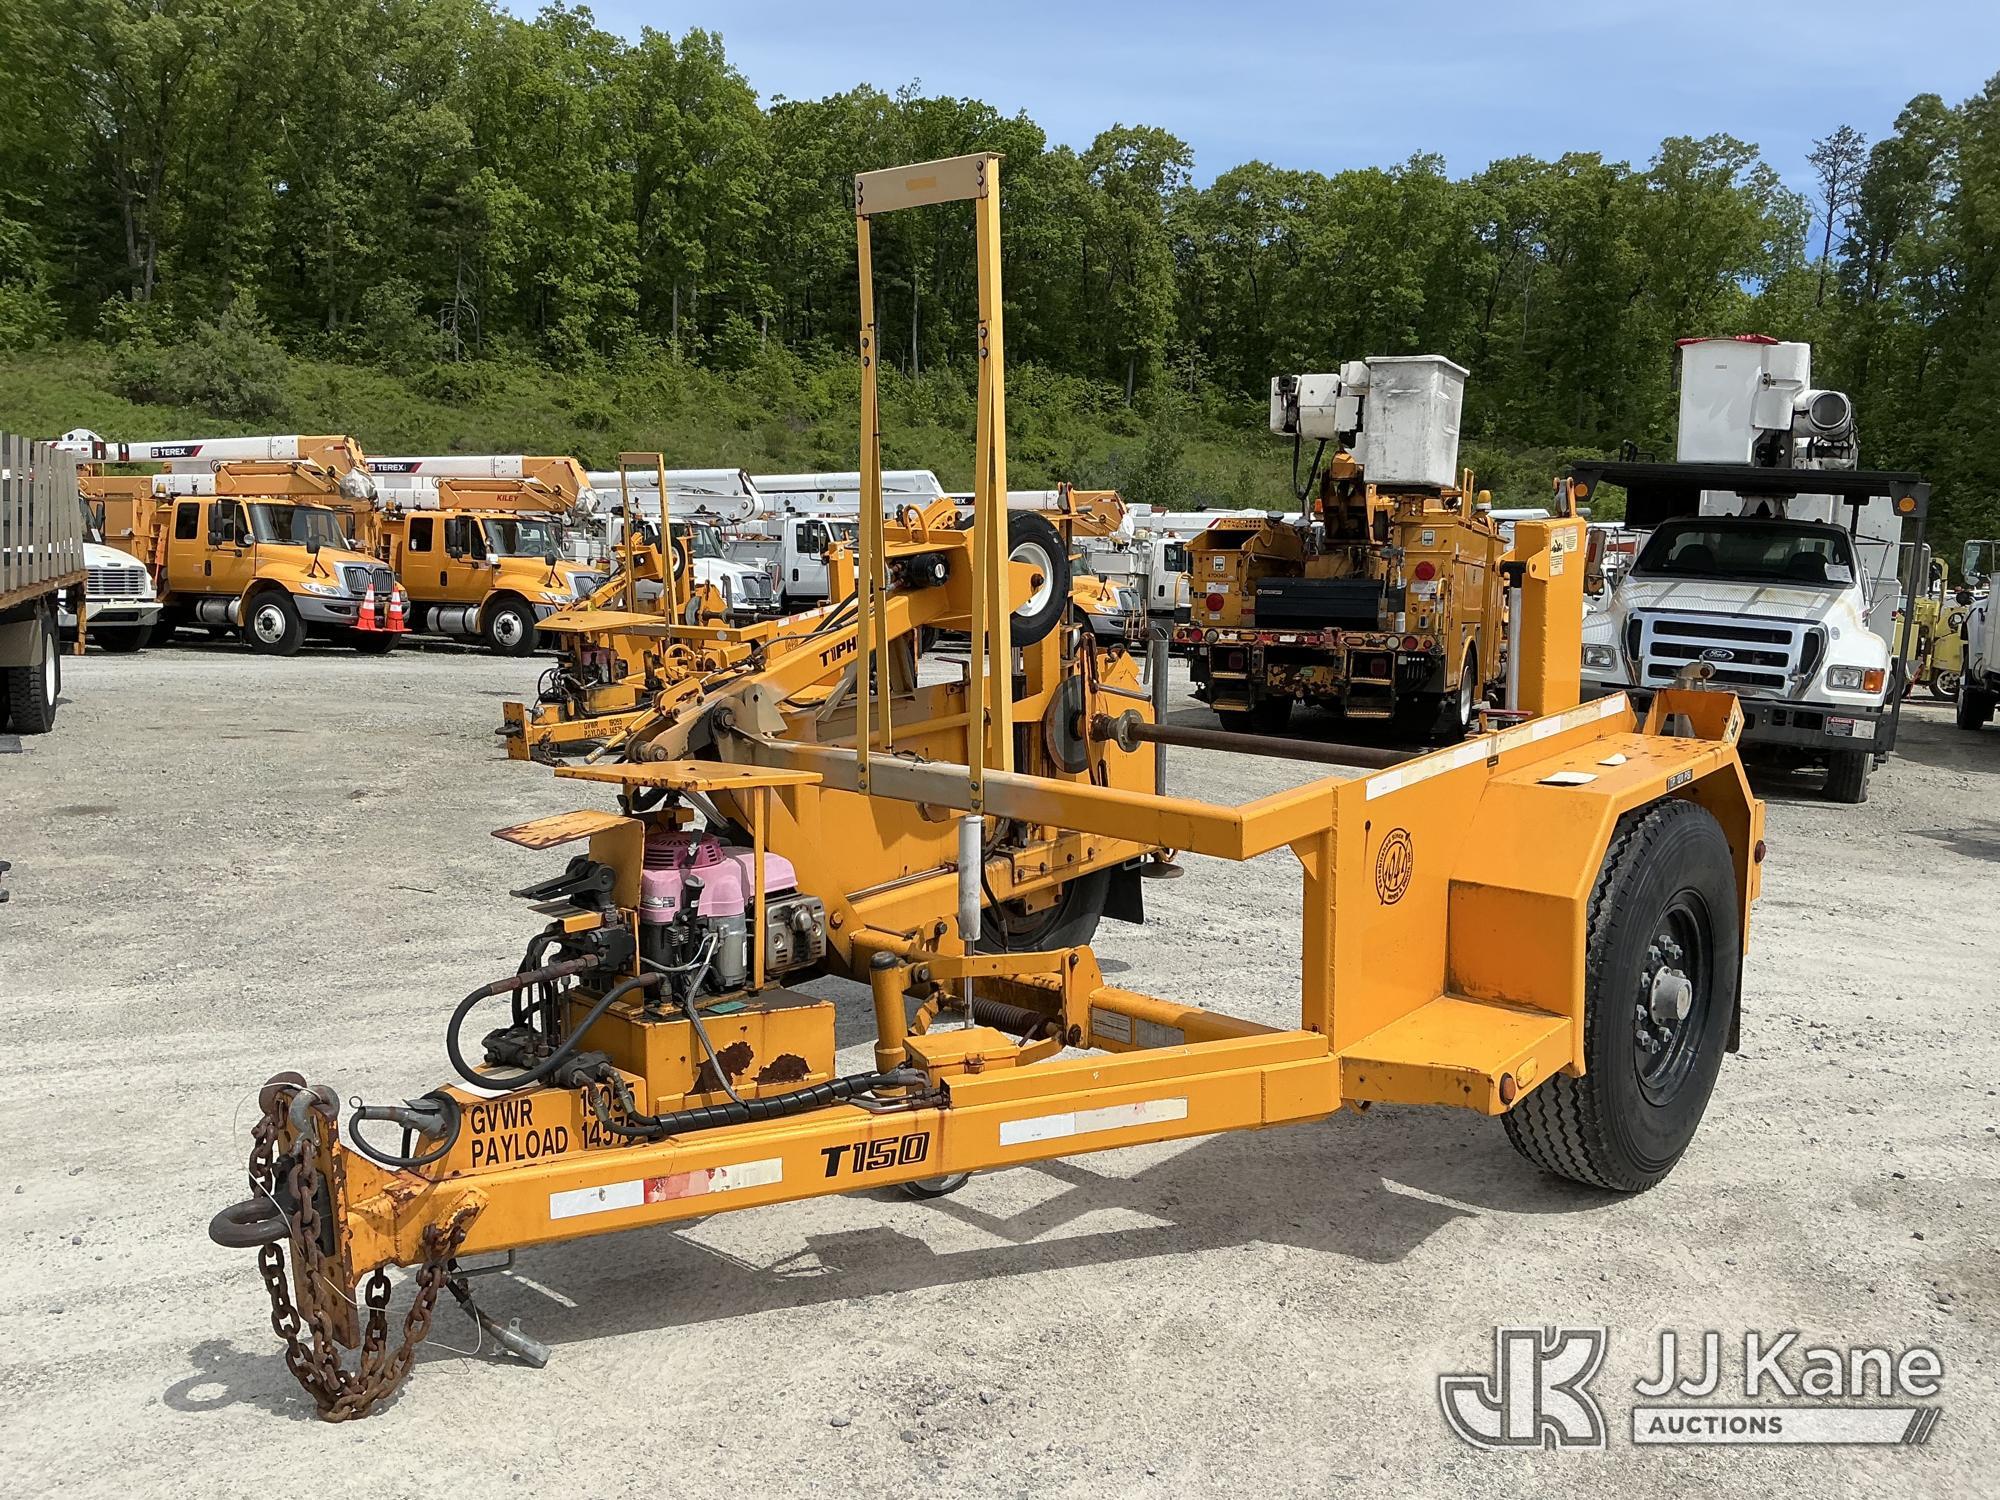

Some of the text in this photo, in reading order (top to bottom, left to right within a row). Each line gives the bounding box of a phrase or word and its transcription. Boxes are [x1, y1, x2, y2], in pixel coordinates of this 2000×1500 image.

[161, 447, 186, 456] TEREX
[377, 463, 404, 471] TEREX
[496, 494, 519, 502] KILEY
[583, 717, 623, 730] GVWR 19055
[583, 727, 607, 739] PAYLOAD
[470, 1098, 533, 1136] GVWR
[471, 1125, 569, 1169] PAYLOAD
[820, 1131, 931, 1178] T150
